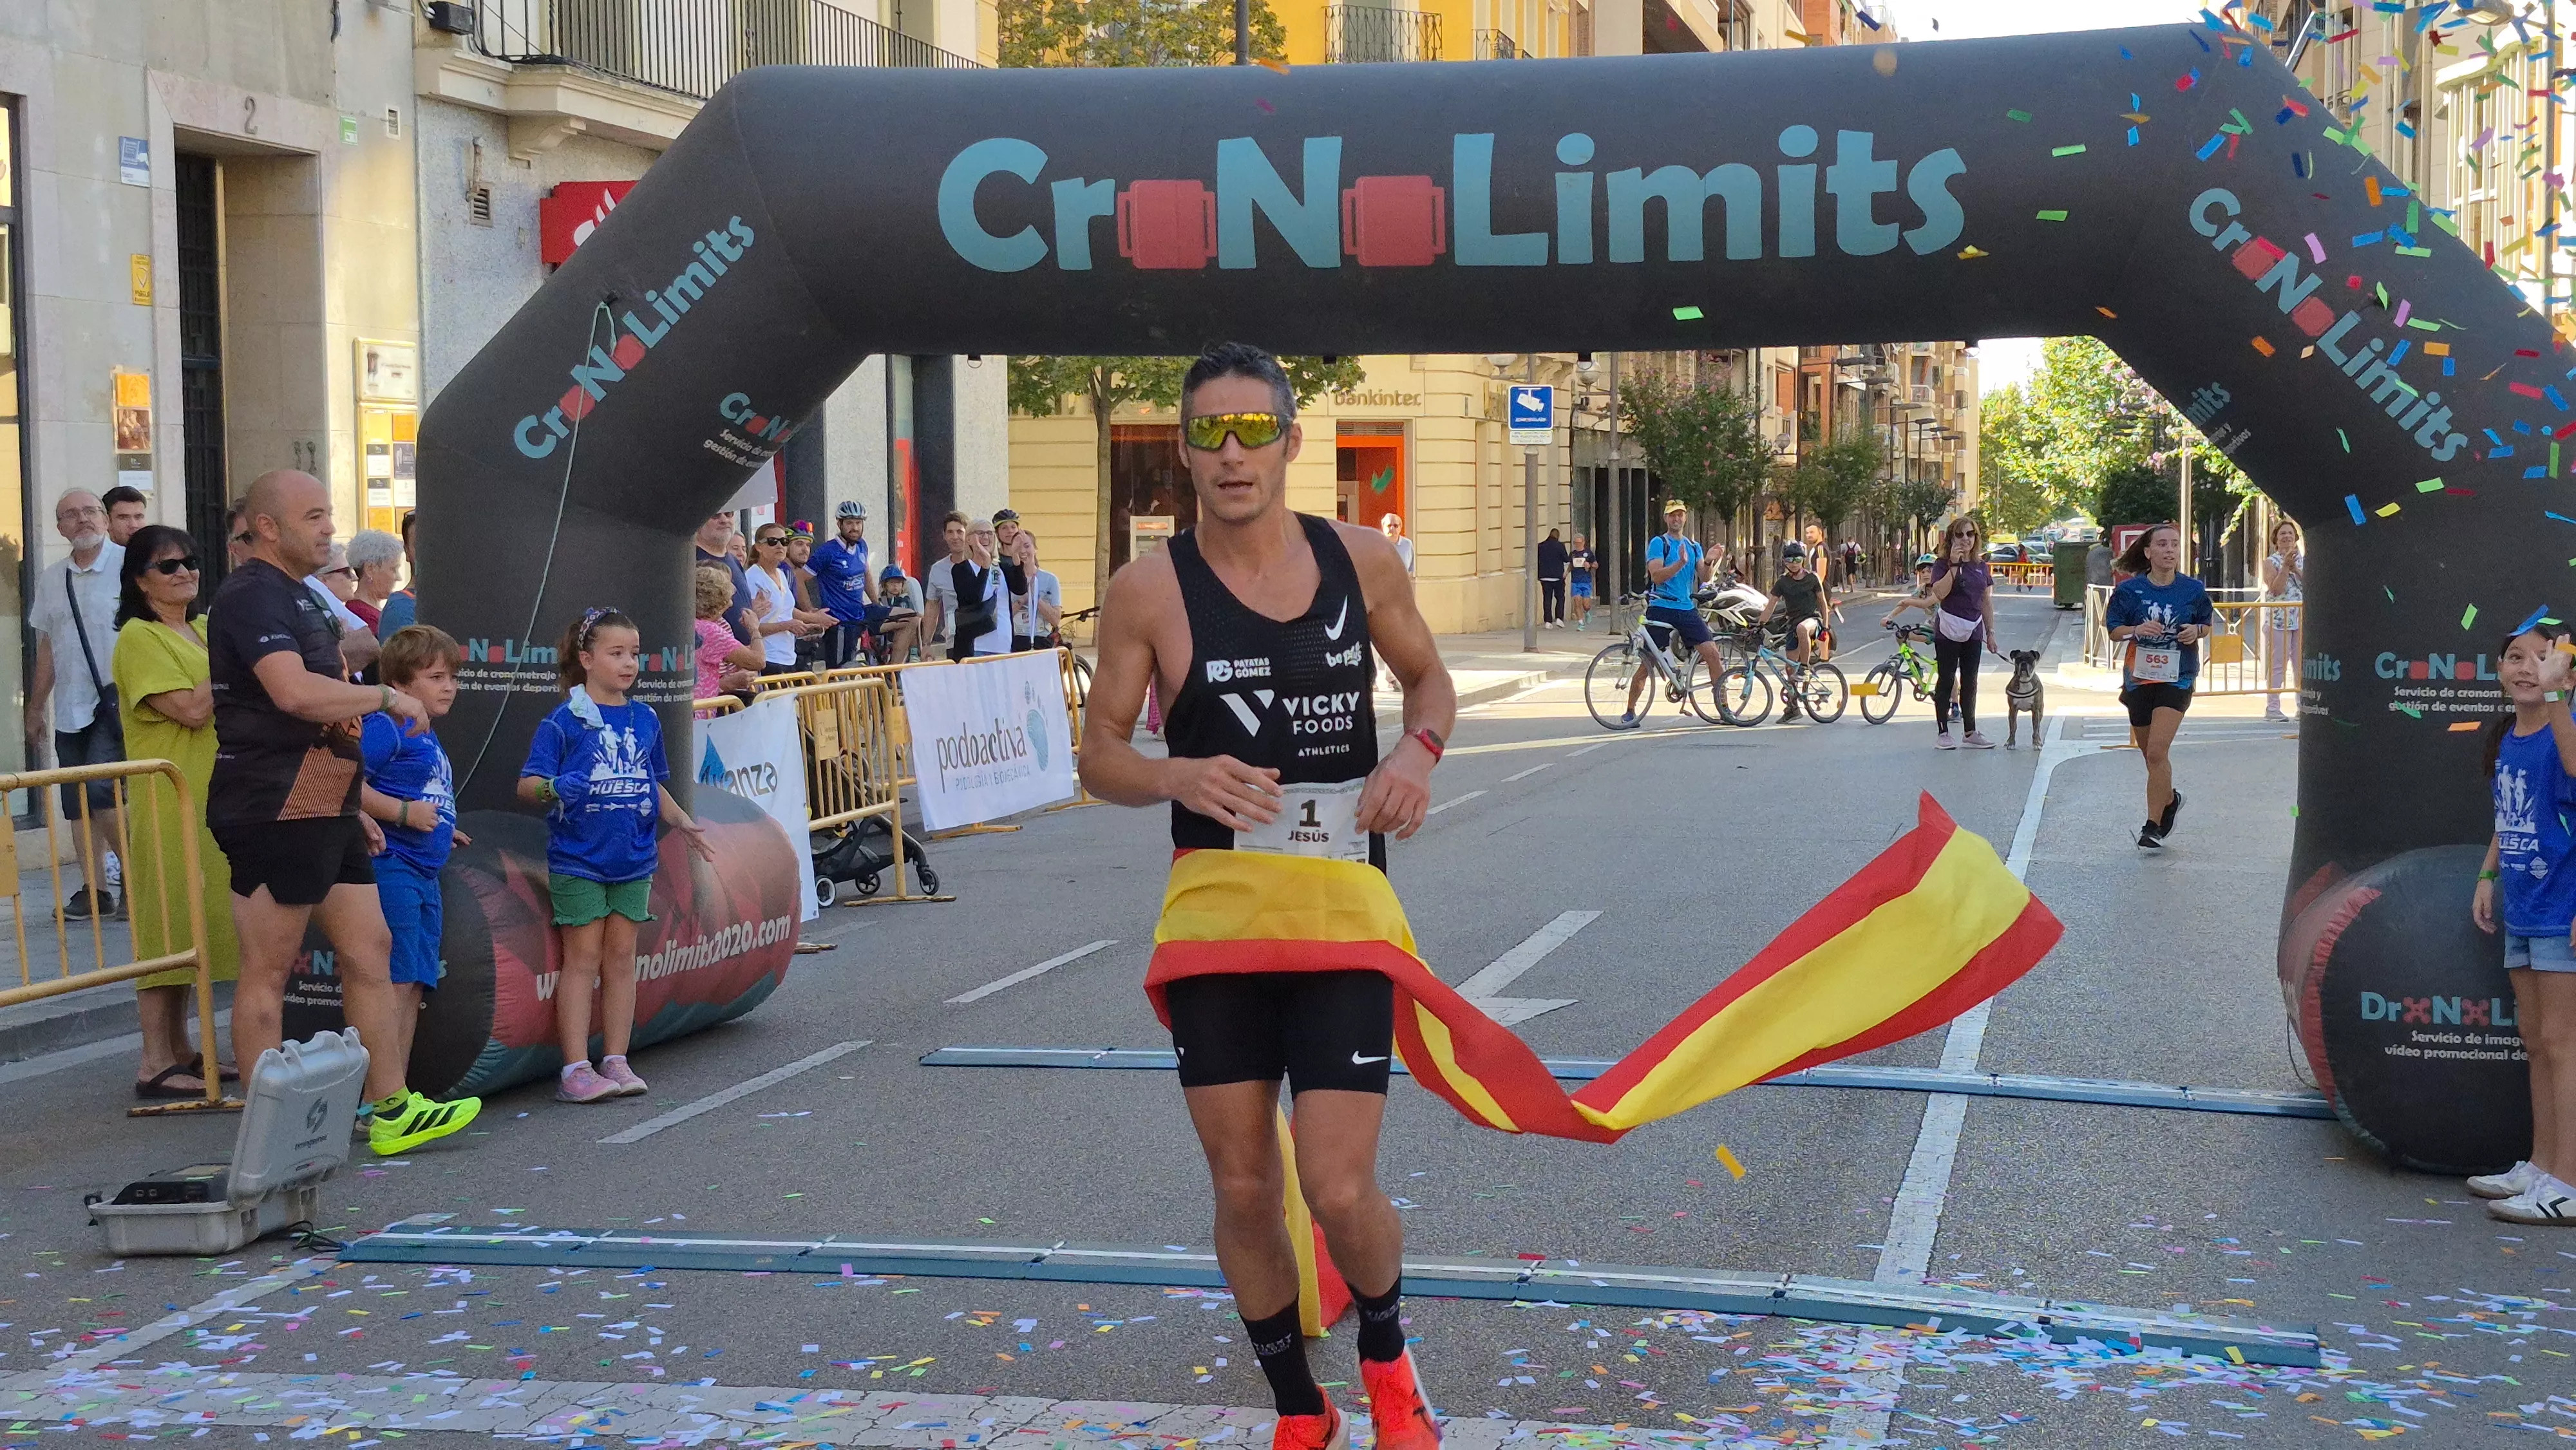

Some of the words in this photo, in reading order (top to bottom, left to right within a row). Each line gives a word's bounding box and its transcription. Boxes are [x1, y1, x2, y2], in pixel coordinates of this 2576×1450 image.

[244, 95, 258, 135] 2
[1233, 657, 1270, 668] PATATAS
[2146, 654, 2168, 664] 563
[1235, 665, 1271, 679] GÓMEZ
[2394, 686, 2438, 697] Servicio
[2439, 687, 2455, 698] de
[1282, 691, 1361, 718] VICKY
[2431, 701, 2447, 712] de
[2449, 703, 2495, 713] eventos
[1293, 715, 1353, 735] FOODS
[936, 717, 1028, 794] podoactiva
[1298, 743, 1350, 757] ATHLETICS
[1299, 799, 1321, 827] 1
[1287, 829, 1330, 843] JESÚS
[298, 980, 333, 993] Servicio
[2411, 1030, 2462, 1044] Servicio
[2464, 1031, 2482, 1045] de
[2384, 1044, 2421, 1057] vídeo
[2423, 1049, 2508, 1061] promocional
